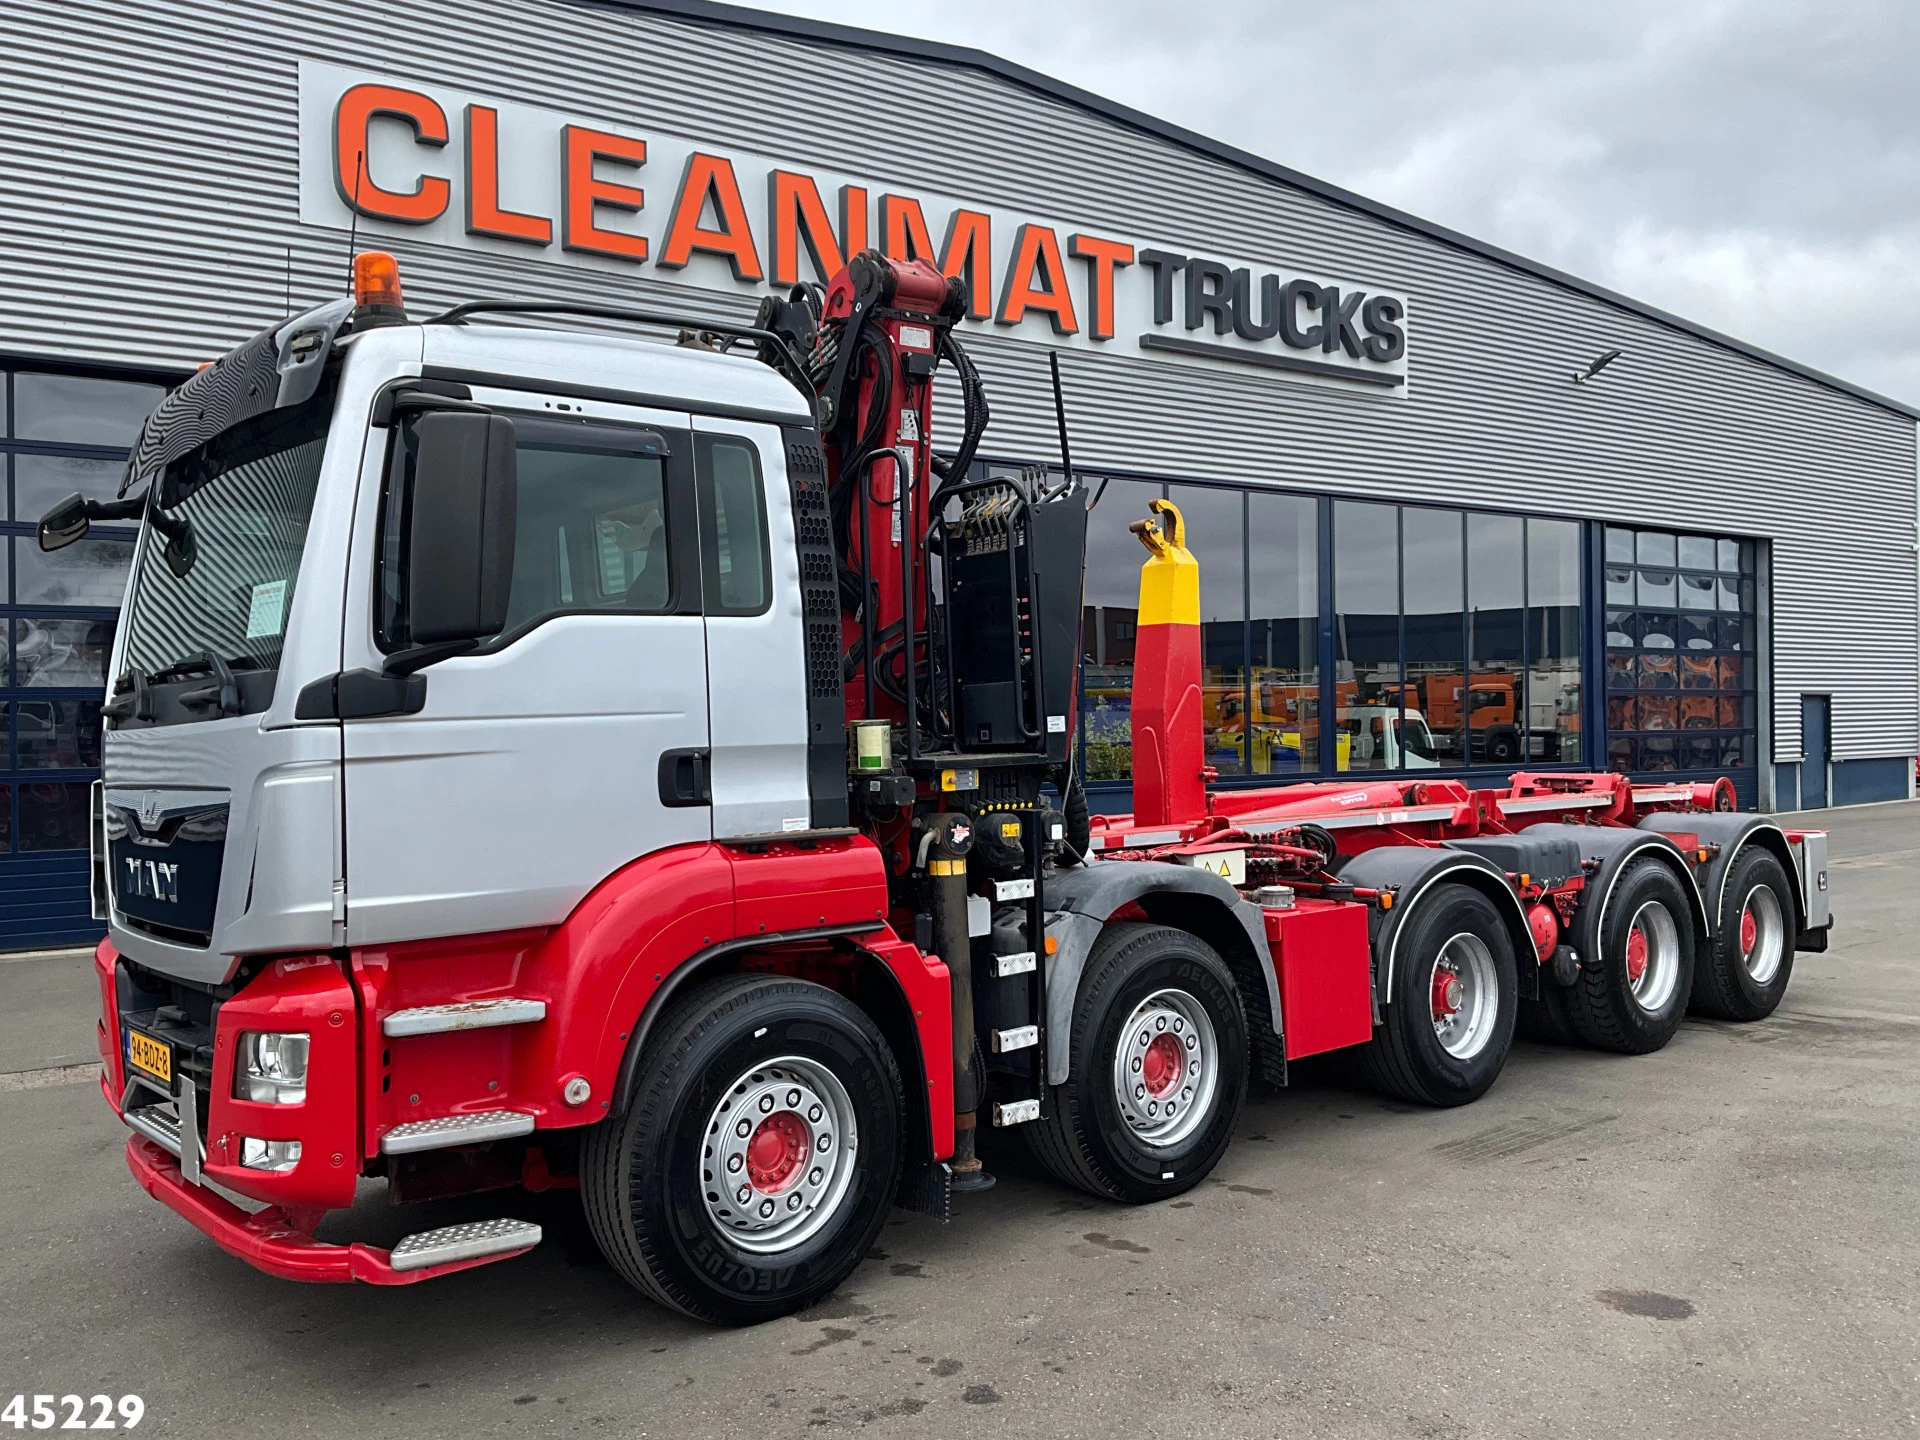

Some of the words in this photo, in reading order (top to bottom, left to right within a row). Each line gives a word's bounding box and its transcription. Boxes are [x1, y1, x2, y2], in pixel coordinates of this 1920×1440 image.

[332, 83, 1134, 341] CLEANMAT
[1139, 248, 1405, 362] TRUCKS
[125, 857, 178, 903] MAN
[131, 1036, 168, 1075] 94-BDZ-8
[692, 1240, 797, 1291] AEOLUS
